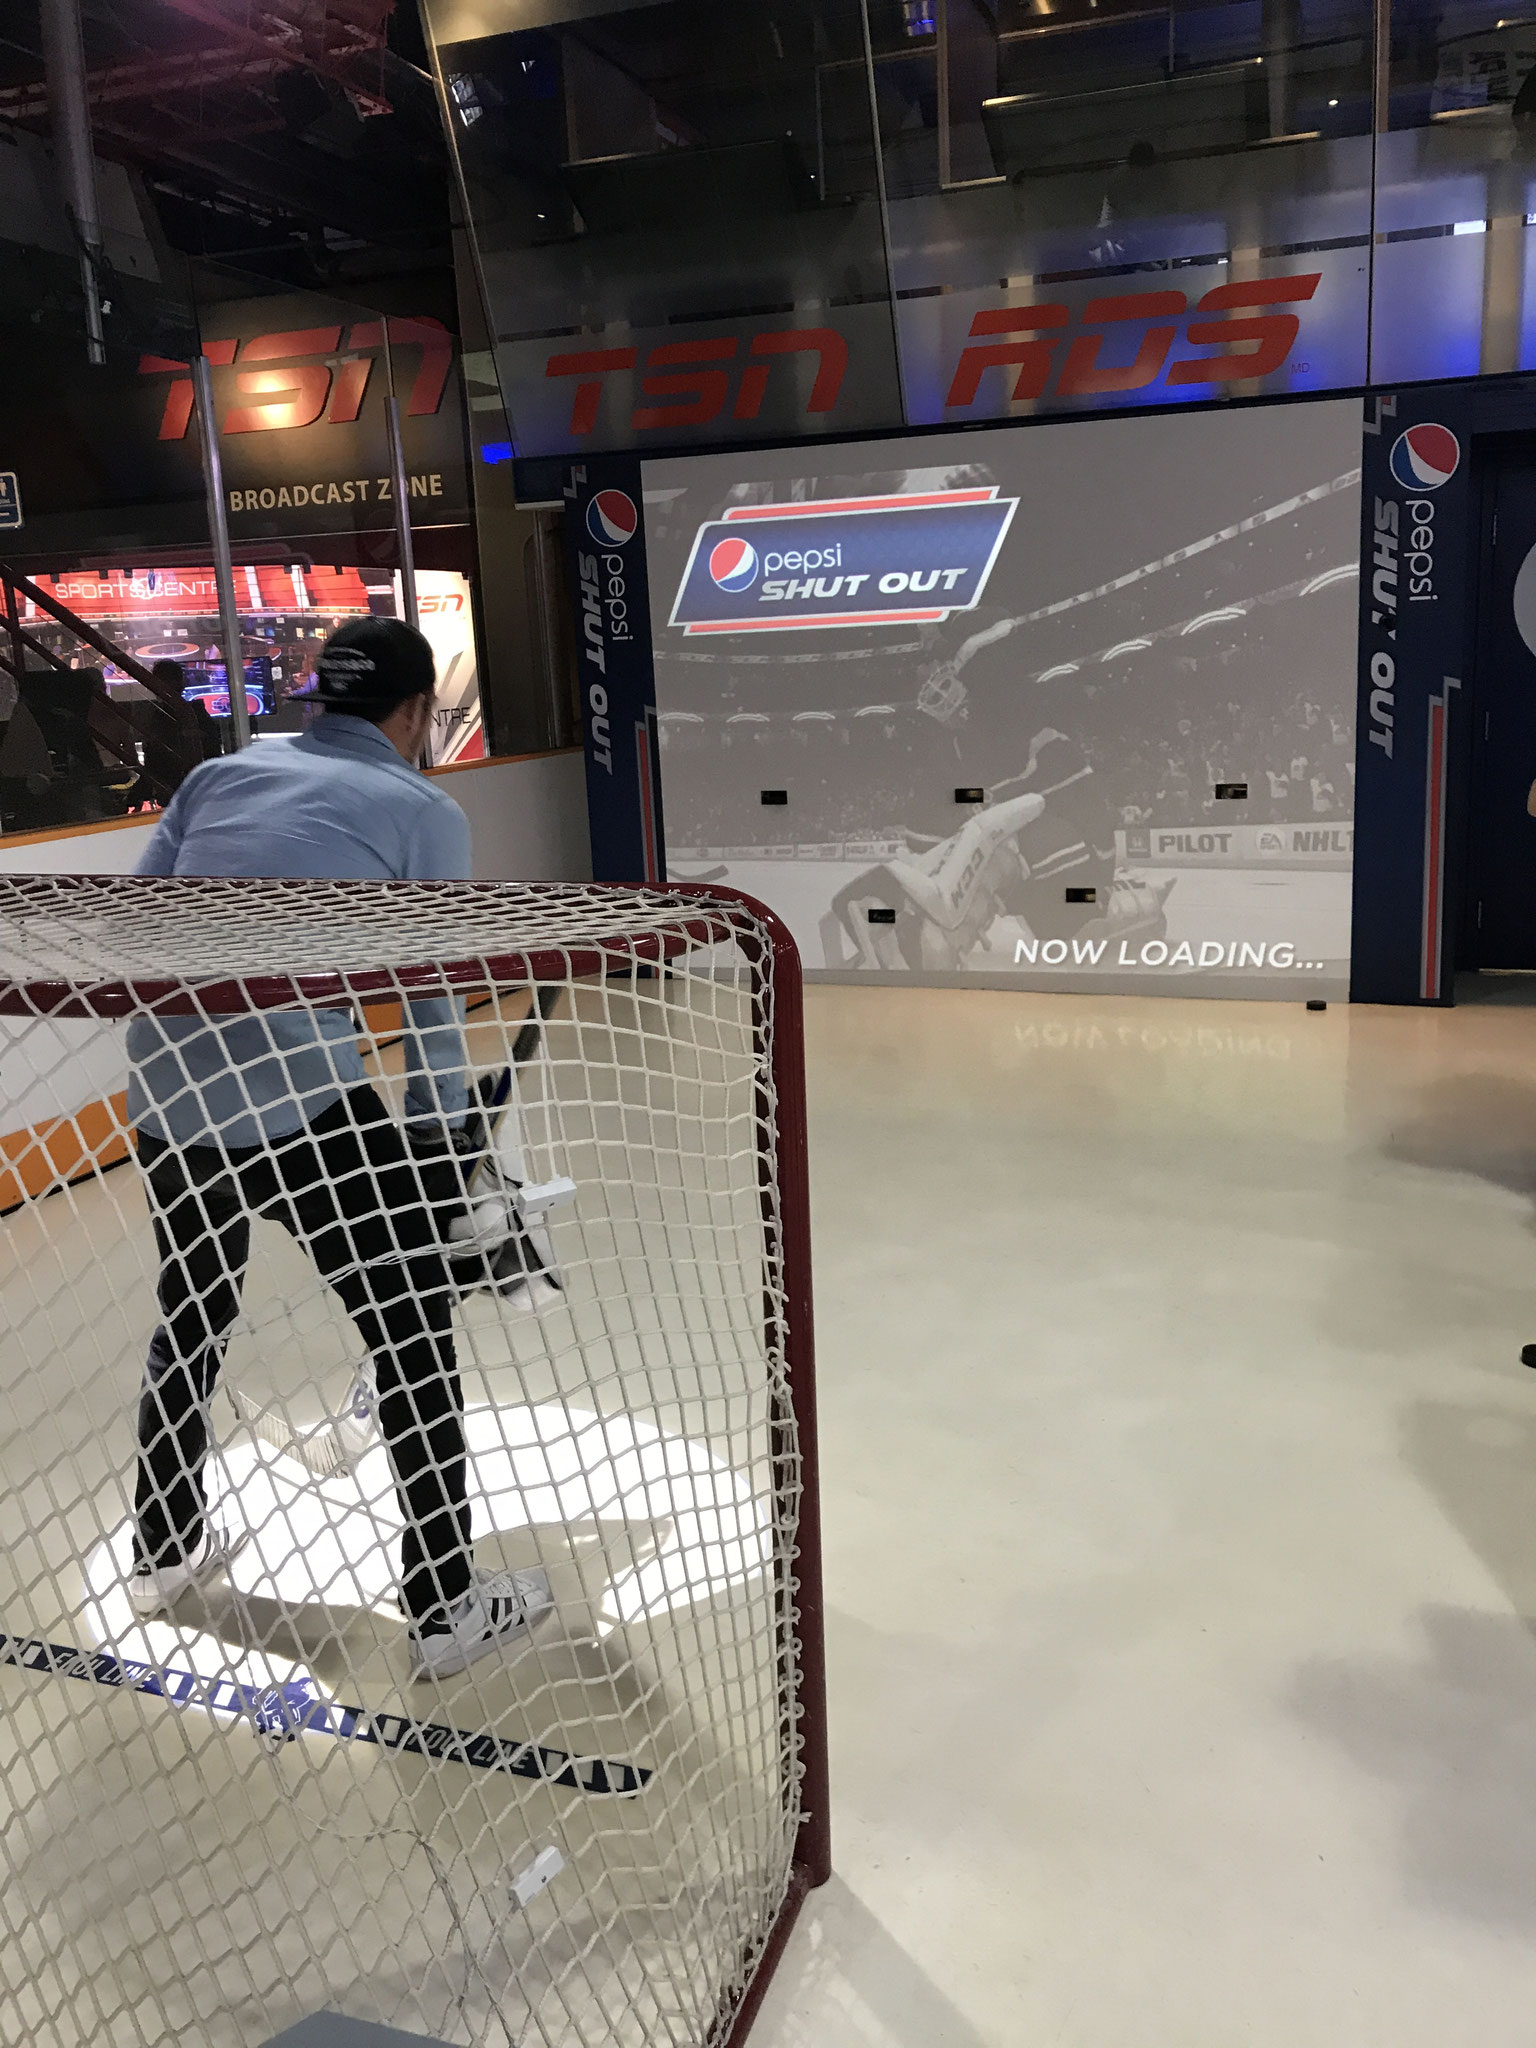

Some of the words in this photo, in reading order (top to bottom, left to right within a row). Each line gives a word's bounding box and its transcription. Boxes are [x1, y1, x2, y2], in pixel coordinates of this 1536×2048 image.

[138, 315, 454, 441] TSN
[545, 327, 849, 435] TSN
[945, 272, 1323, 407] RDS
[230, 480, 369, 511] BROADCAST
[377, 474, 443, 500] ZNE
[758, 574, 871, 601] SHUT
[878, 567, 968, 594] OUT
[764, 543, 842, 577] pepsi
[1403, 499, 1439, 601] pepsi
[578, 550, 606, 675] SHUT
[601, 554, 634, 641] pepsi
[589, 683, 613, 776] OUT
[1369, 651, 1396, 761] OUT
[1159, 833, 1233, 853] PILOT
[1013, 938, 1108, 964] NOW
[1117, 940, 1324, 968] LOADING...
